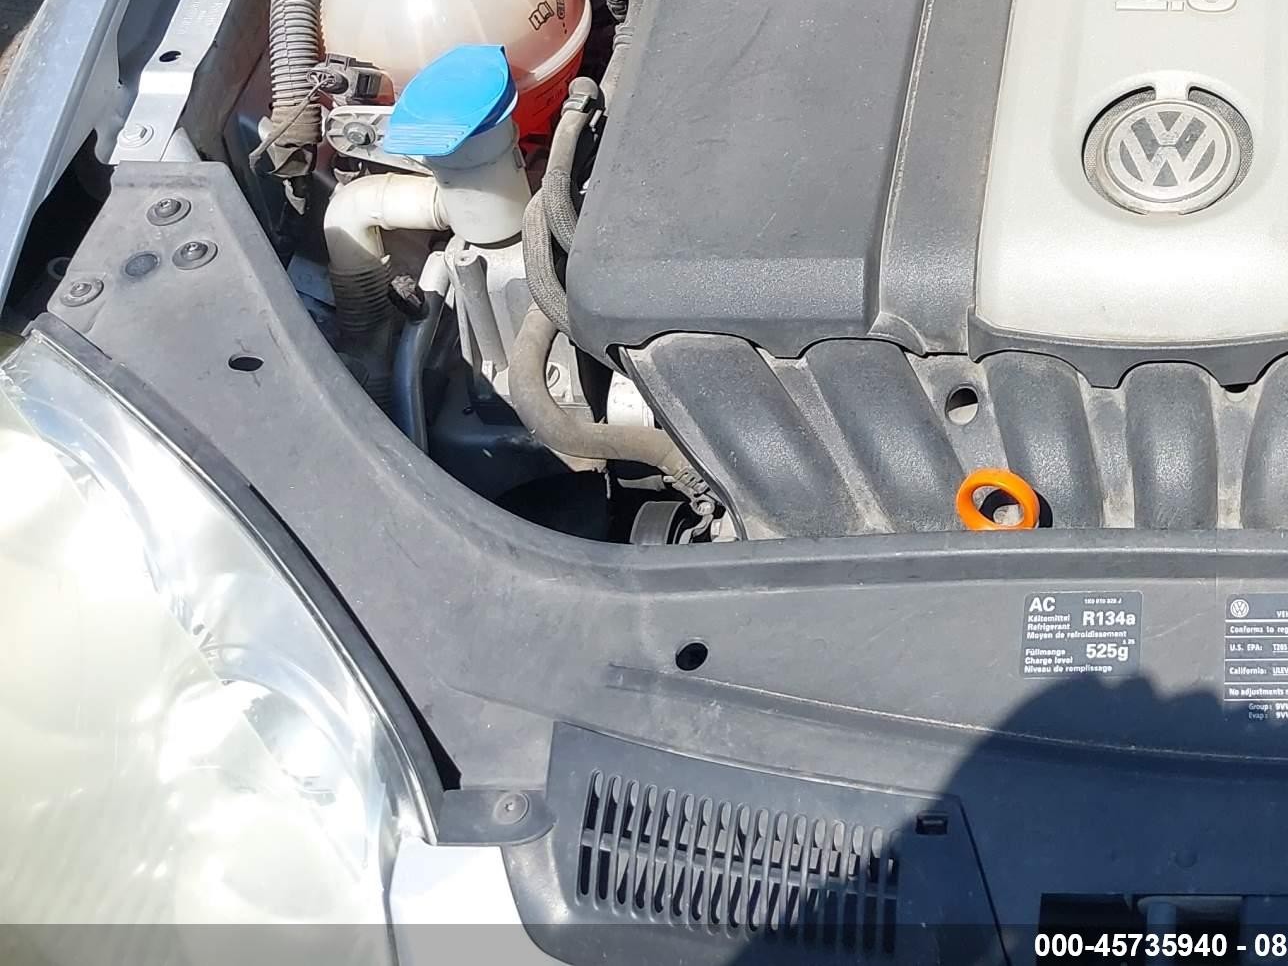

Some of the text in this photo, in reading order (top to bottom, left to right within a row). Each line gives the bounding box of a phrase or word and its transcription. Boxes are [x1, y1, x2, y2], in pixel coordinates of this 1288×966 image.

[1029, 597, 1055, 612] AC
[1083, 611, 1136, 625] R134a
[1027, 623, 1070, 631] Refrigerant
[1026, 631, 1053, 640] Moyen
[1025, 648, 1066, 657] Füllmenge
[1086, 643, 1129, 661] 525g
[1025, 656, 1073, 665] Charge level
[1024, 665, 1051, 673] Niveau
[1065, 664, 1113, 673] remplissage
[1240, 688, 1284, 697] adjustments
